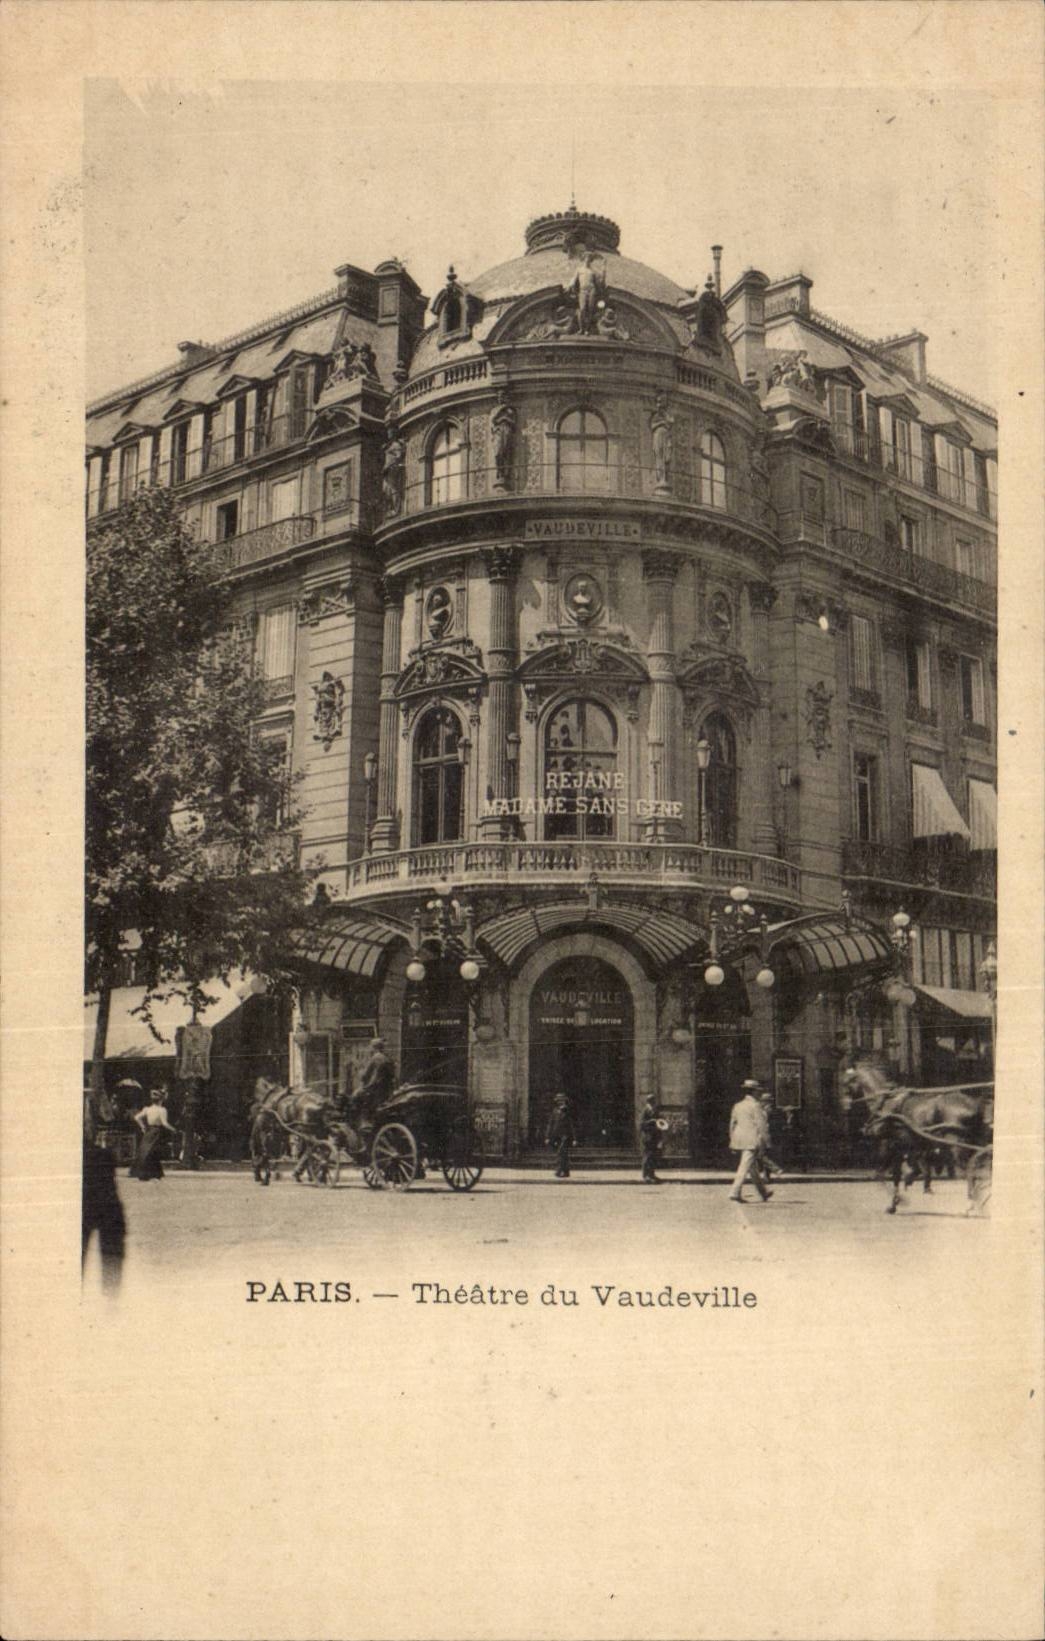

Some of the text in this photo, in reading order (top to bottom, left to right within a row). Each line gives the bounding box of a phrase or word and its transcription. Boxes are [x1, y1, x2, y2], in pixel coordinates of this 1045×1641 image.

[533, 521, 633, 537] VAUDEVILLE
[545, 772, 626, 789] REJANE
[482, 797, 568, 817] MADAME
[575, 796, 630, 815] SANS
